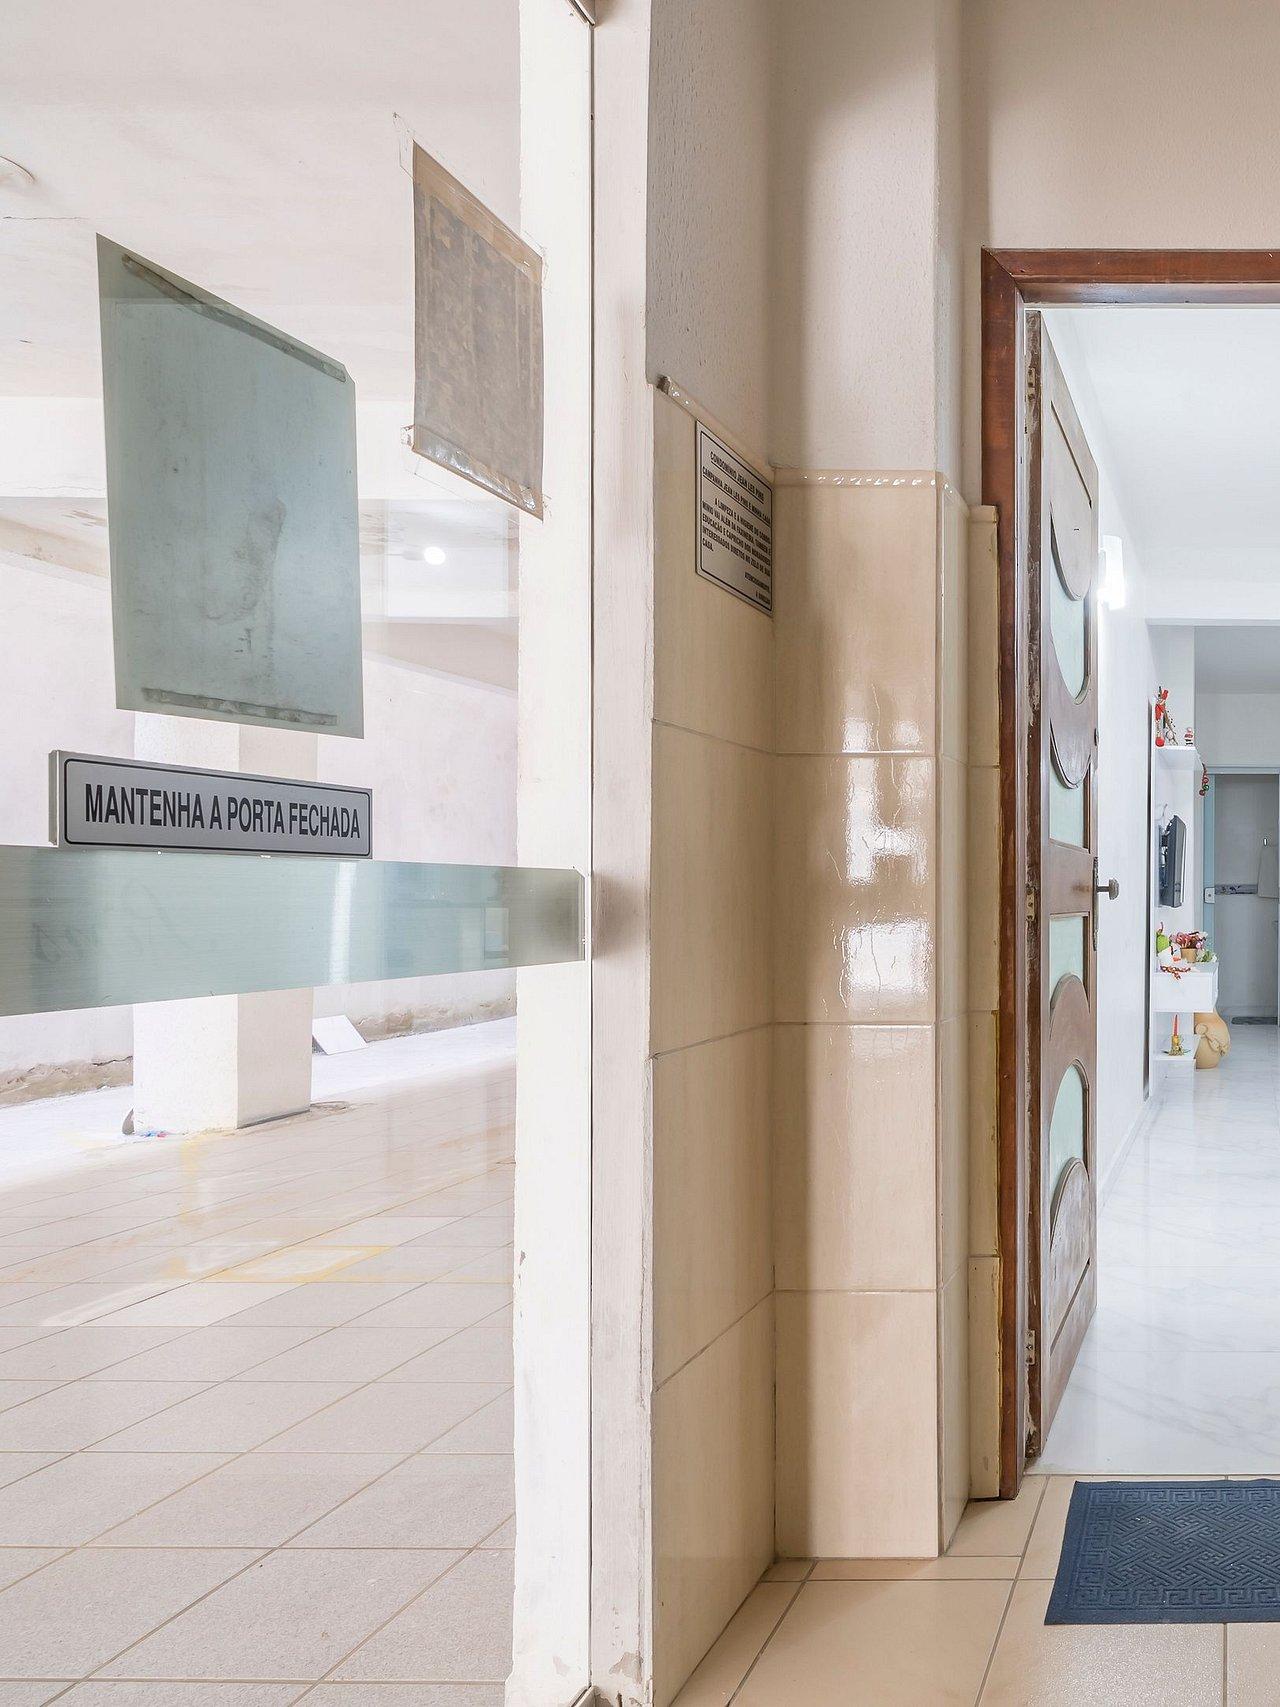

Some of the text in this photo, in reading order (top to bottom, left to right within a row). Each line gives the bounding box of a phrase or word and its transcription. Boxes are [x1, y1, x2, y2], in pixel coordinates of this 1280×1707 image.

[85, 784, 360, 838] MANTENHA A PORTA FECHADA
